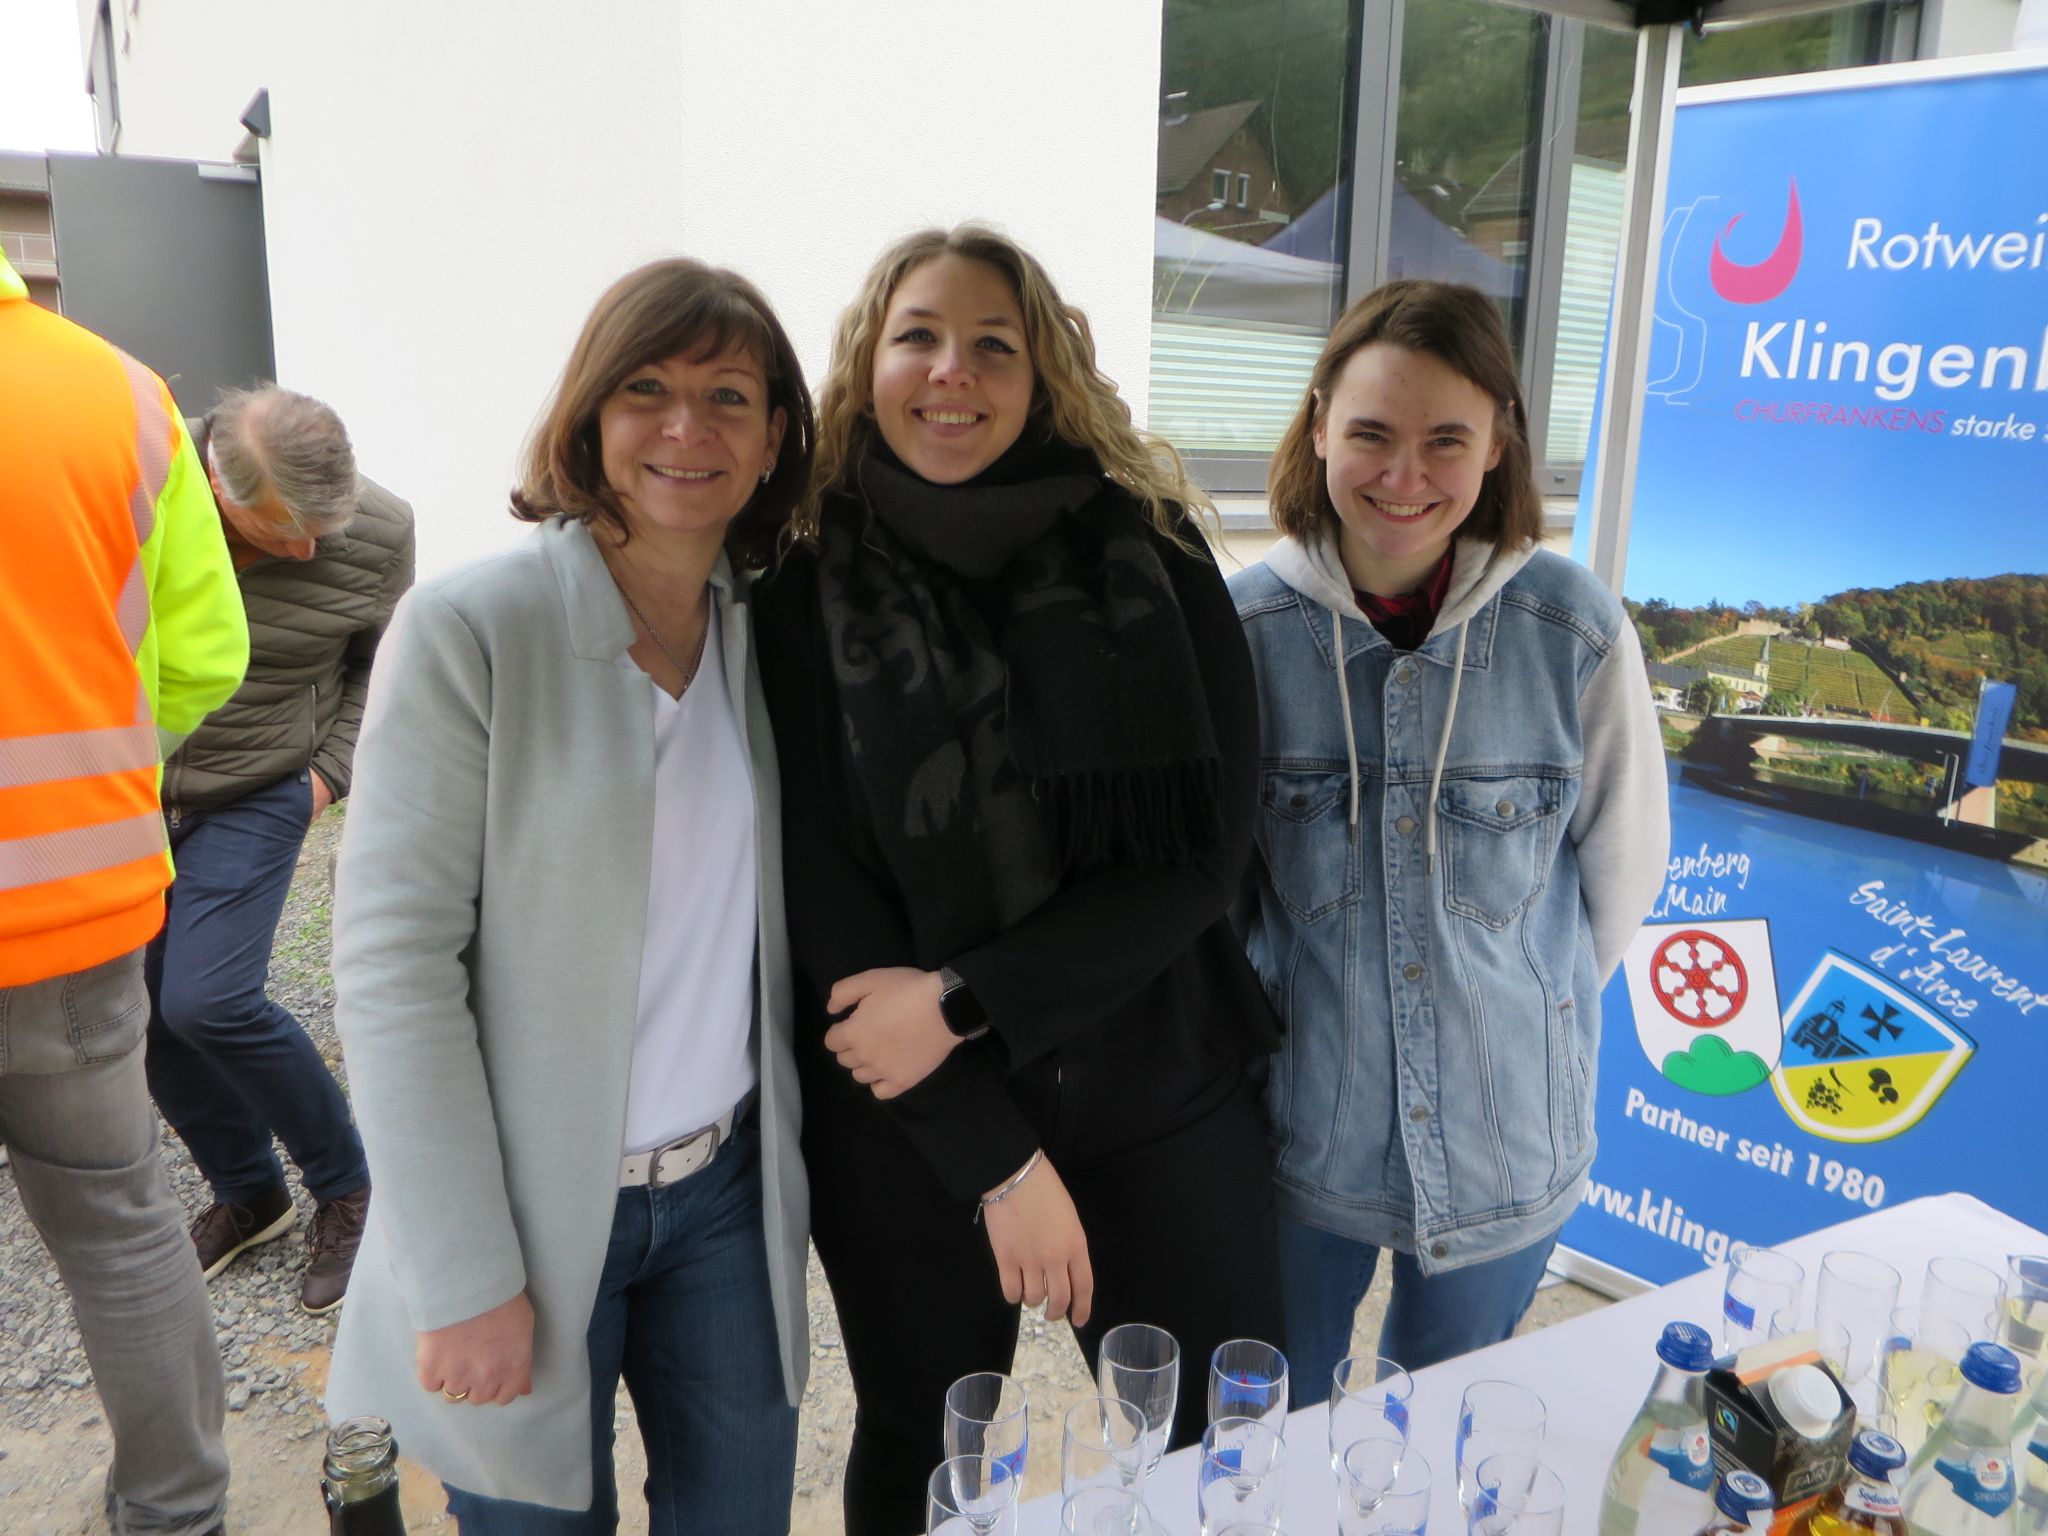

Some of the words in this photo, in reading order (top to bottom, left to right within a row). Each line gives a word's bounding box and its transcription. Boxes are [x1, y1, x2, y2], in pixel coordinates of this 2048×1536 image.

[1846, 212, 2048, 270] Rotwei
[1740, 319, 2048, 401] Klingen
[1735, 399, 1948, 434] CHURFRANKENS
[1952, 413, 2036, 441] starke
[1667, 843, 1750, 890] enberg
[1625, 1086, 1729, 1153] Partner
[1735, 1138, 1794, 1177] seit
[1806, 1152, 1886, 1208] 1980
